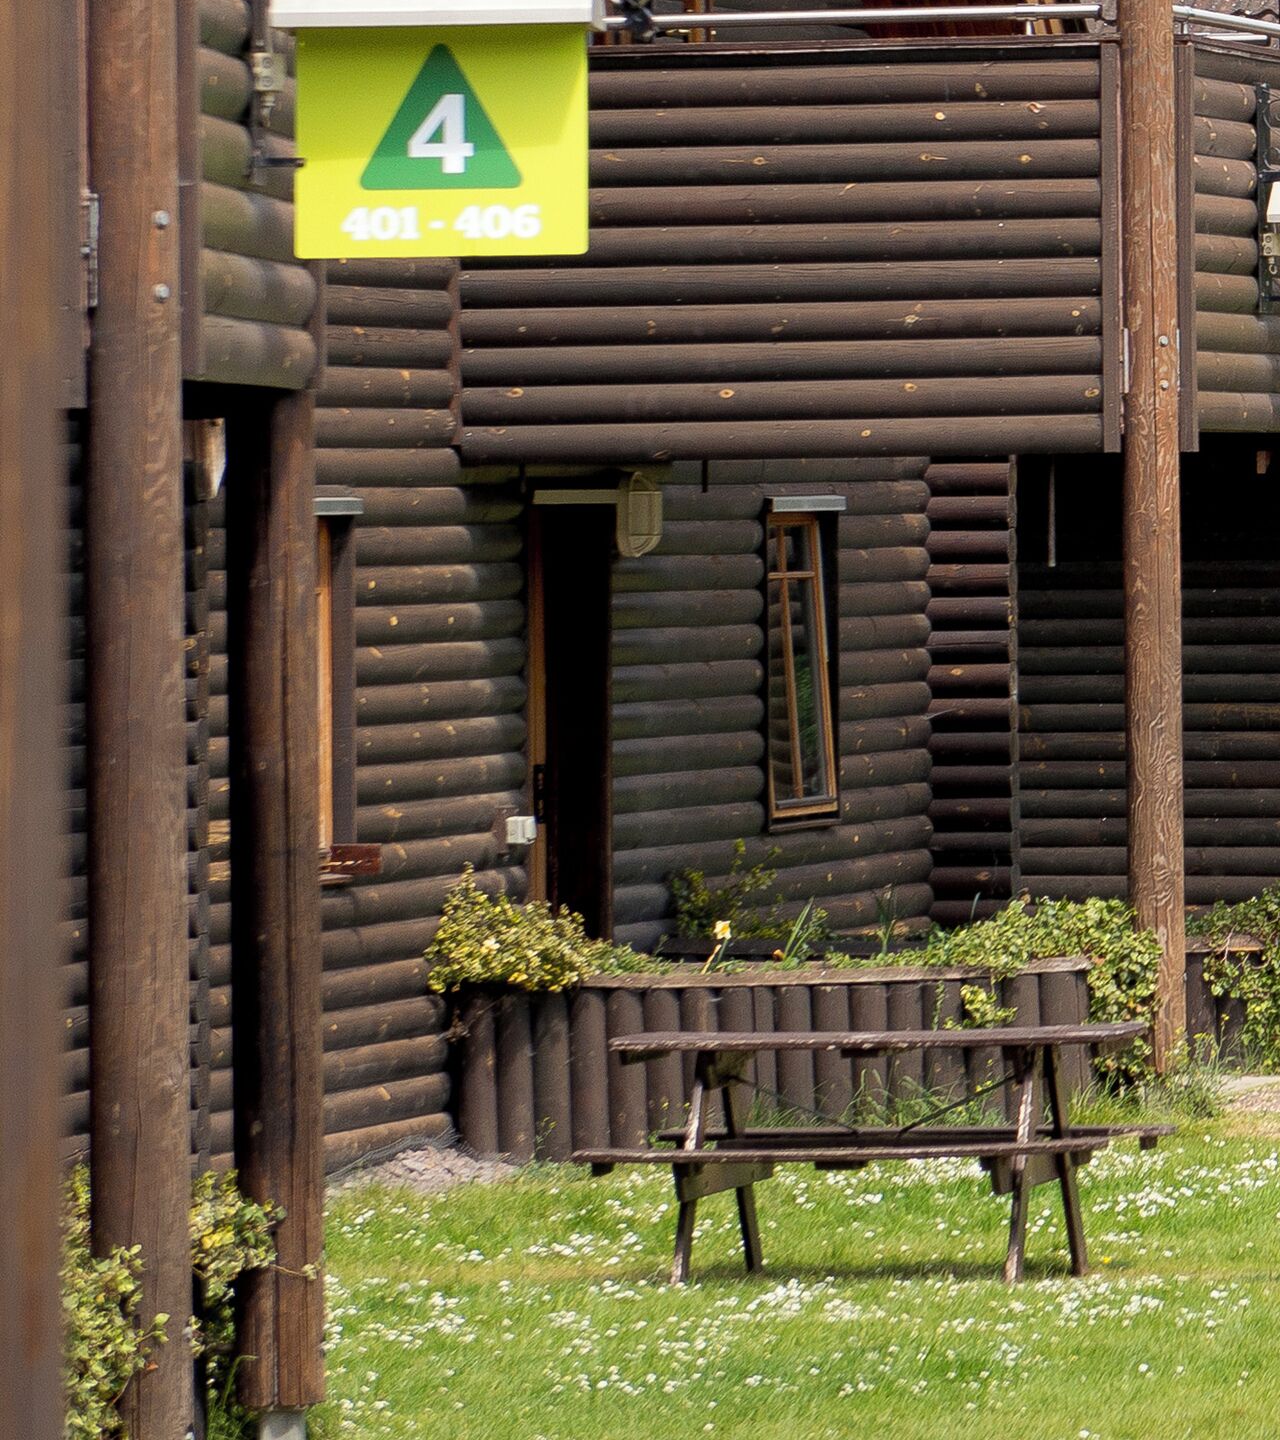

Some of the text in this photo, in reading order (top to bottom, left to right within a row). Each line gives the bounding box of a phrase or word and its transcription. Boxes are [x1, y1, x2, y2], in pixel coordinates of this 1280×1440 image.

[407, 93, 474, 174] 4
[341, 204, 541, 241] 401 - 406
